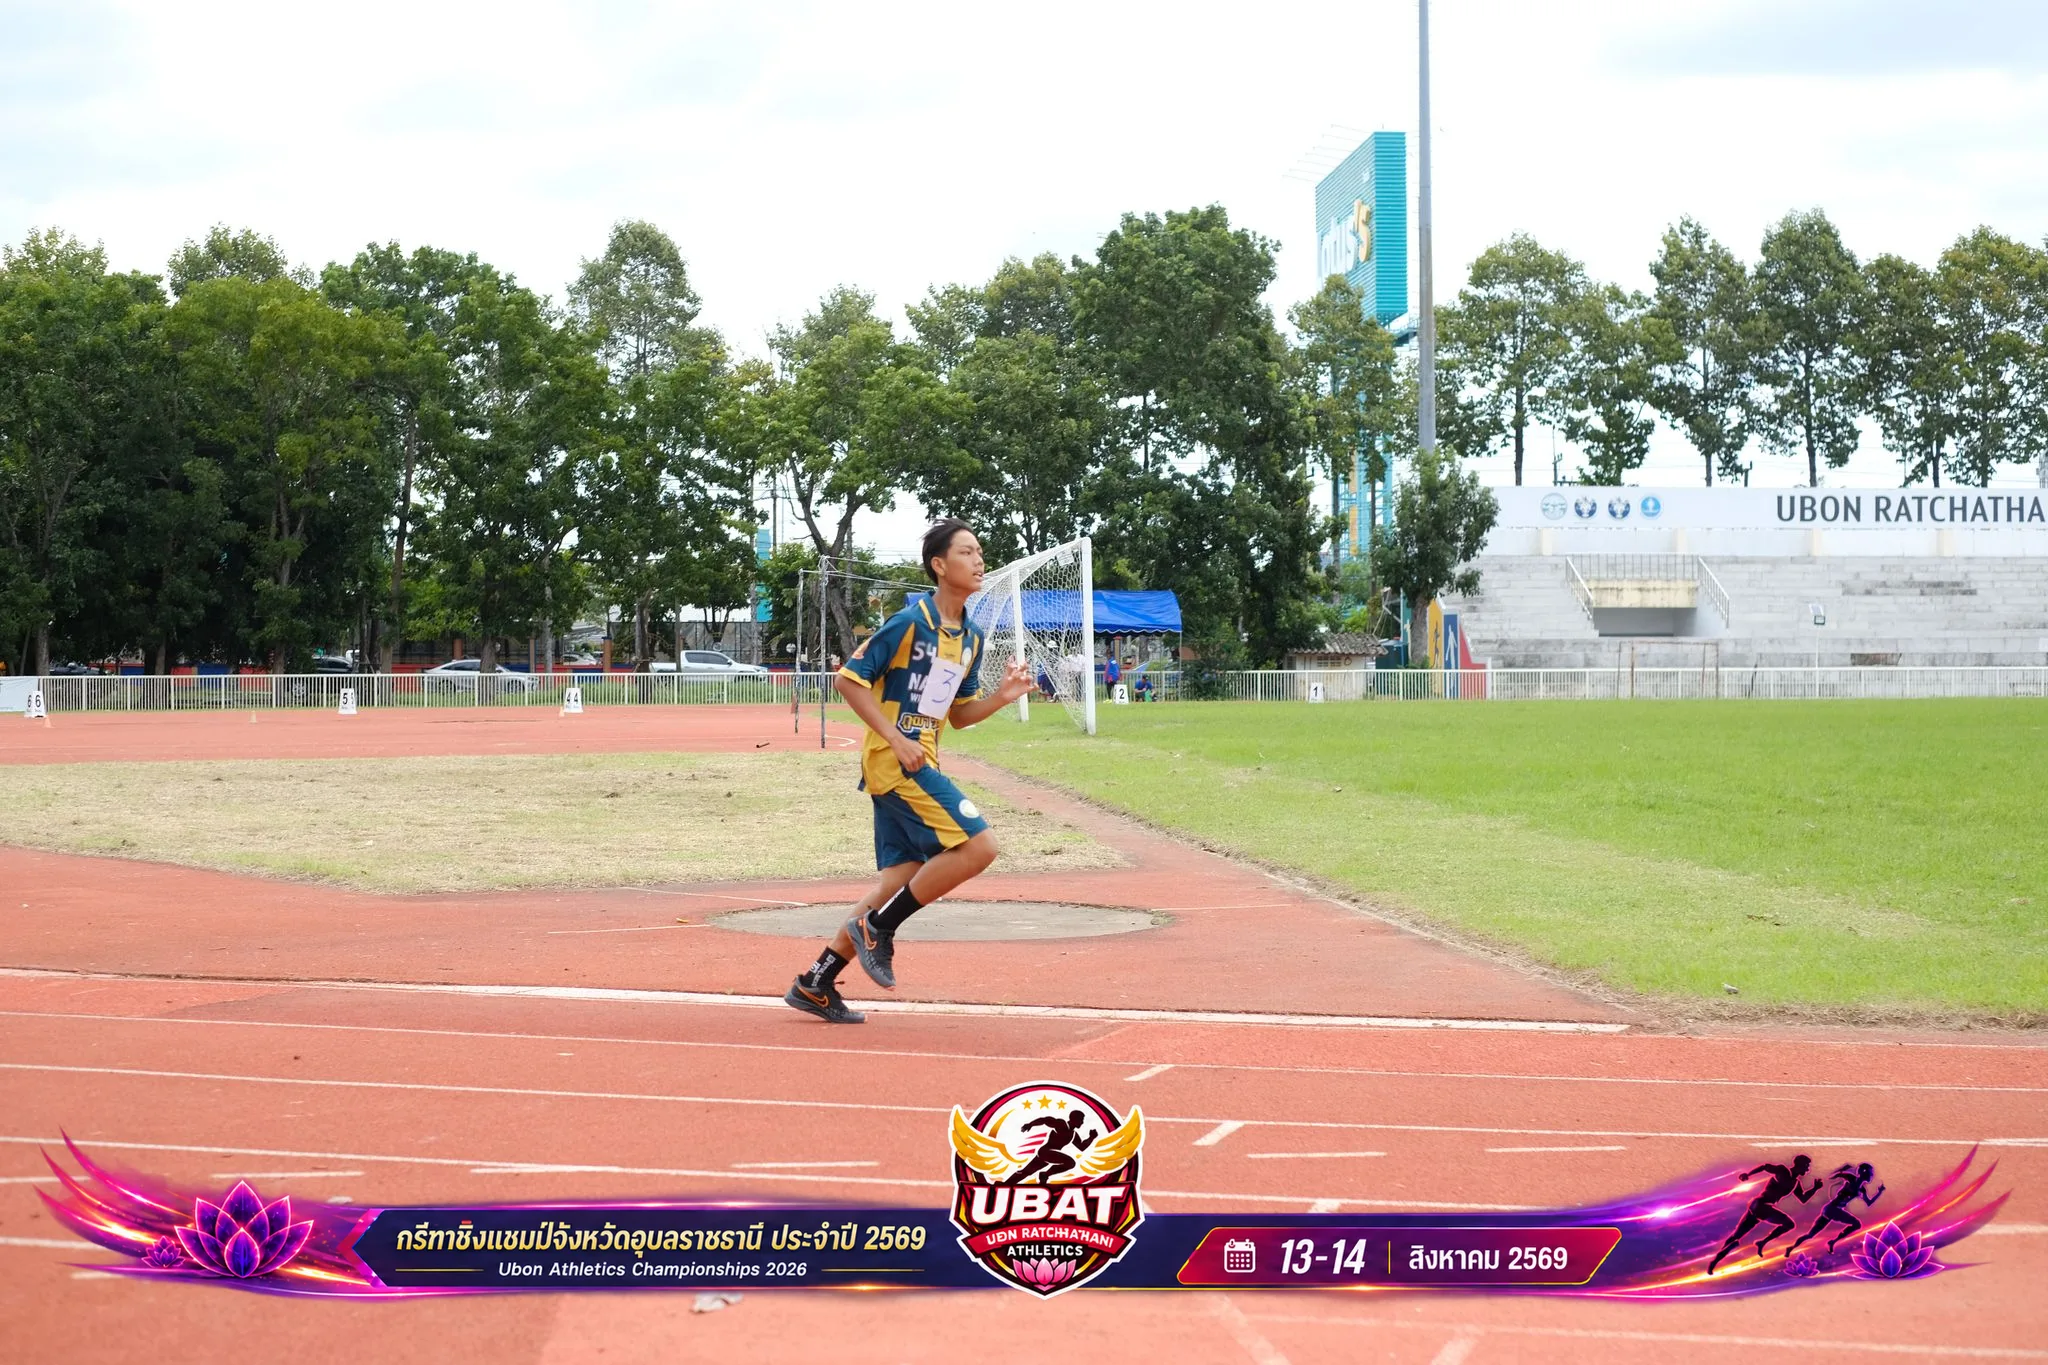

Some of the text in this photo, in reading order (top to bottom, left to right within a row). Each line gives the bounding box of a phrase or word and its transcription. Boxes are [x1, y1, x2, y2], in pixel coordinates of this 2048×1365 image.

[1776, 495, 2046, 522] UBON RATCHATHA
[932, 668, 956, 704] 3
[1313, 686, 1318, 697] 1
[342, 692, 348, 705] 5
[573, 692, 578, 704] 4
[1119, 688, 1125, 700] 2
[35, 694, 41, 708] 6
